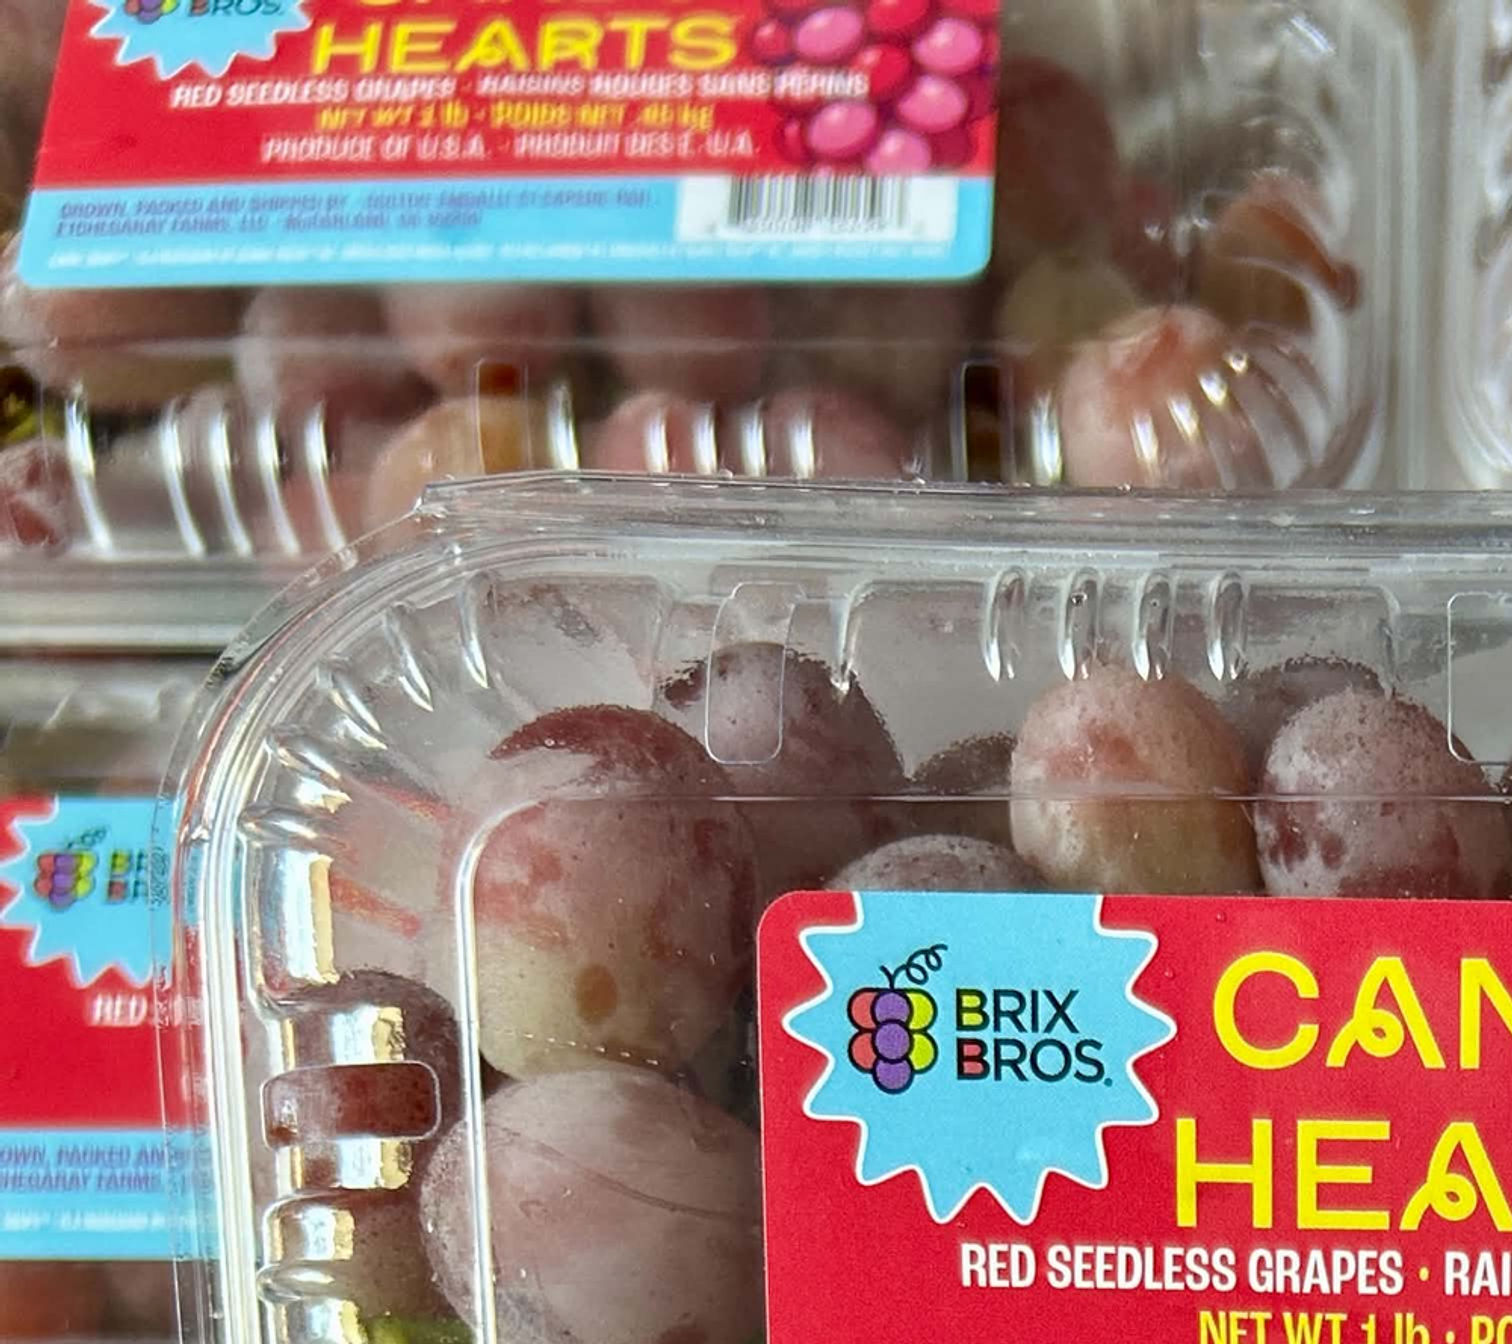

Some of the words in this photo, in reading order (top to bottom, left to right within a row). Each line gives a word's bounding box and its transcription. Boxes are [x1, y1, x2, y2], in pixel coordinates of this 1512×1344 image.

[956, 989, 1080, 1033] BRIX
[960, 1243, 1036, 1288] RED
[1047, 1244, 1236, 1292] SEEDLESS
[1248, 1248, 1403, 1295] GRAPES
